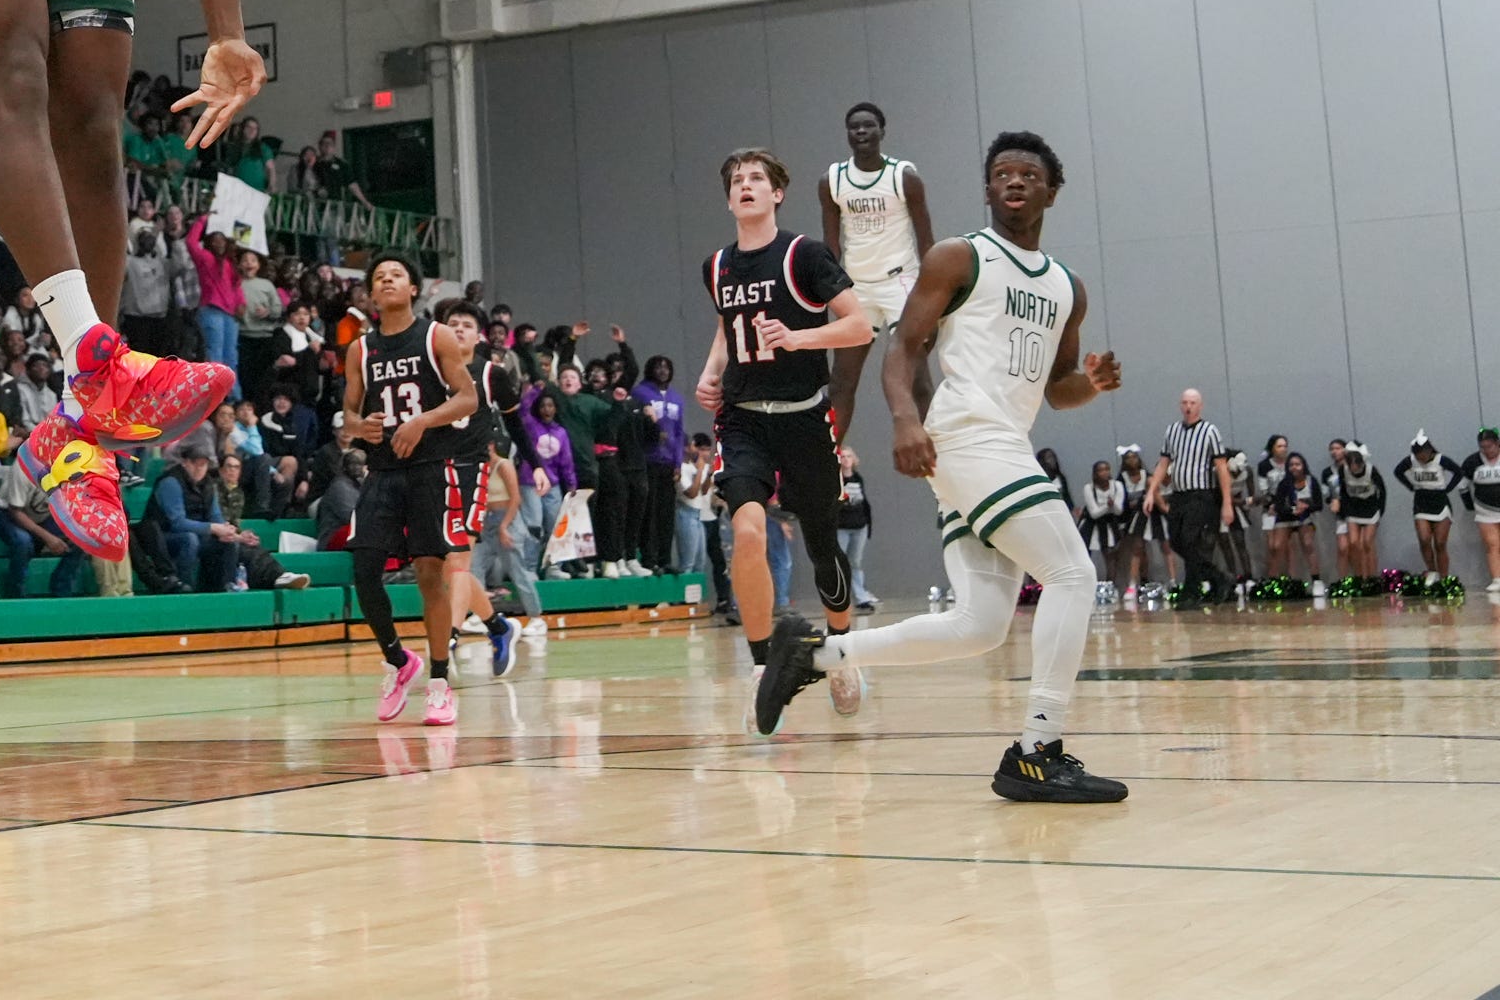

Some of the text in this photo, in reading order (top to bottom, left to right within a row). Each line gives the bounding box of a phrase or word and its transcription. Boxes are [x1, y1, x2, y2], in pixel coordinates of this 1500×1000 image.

[847, 197, 886, 214] NORTH
[722, 280, 775, 309] EAST
[1005, 286, 1058, 330] NORTH
[372, 356, 421, 382] EAST
[1008, 327, 1045, 383] 10
[380, 382, 422, 428] 13
